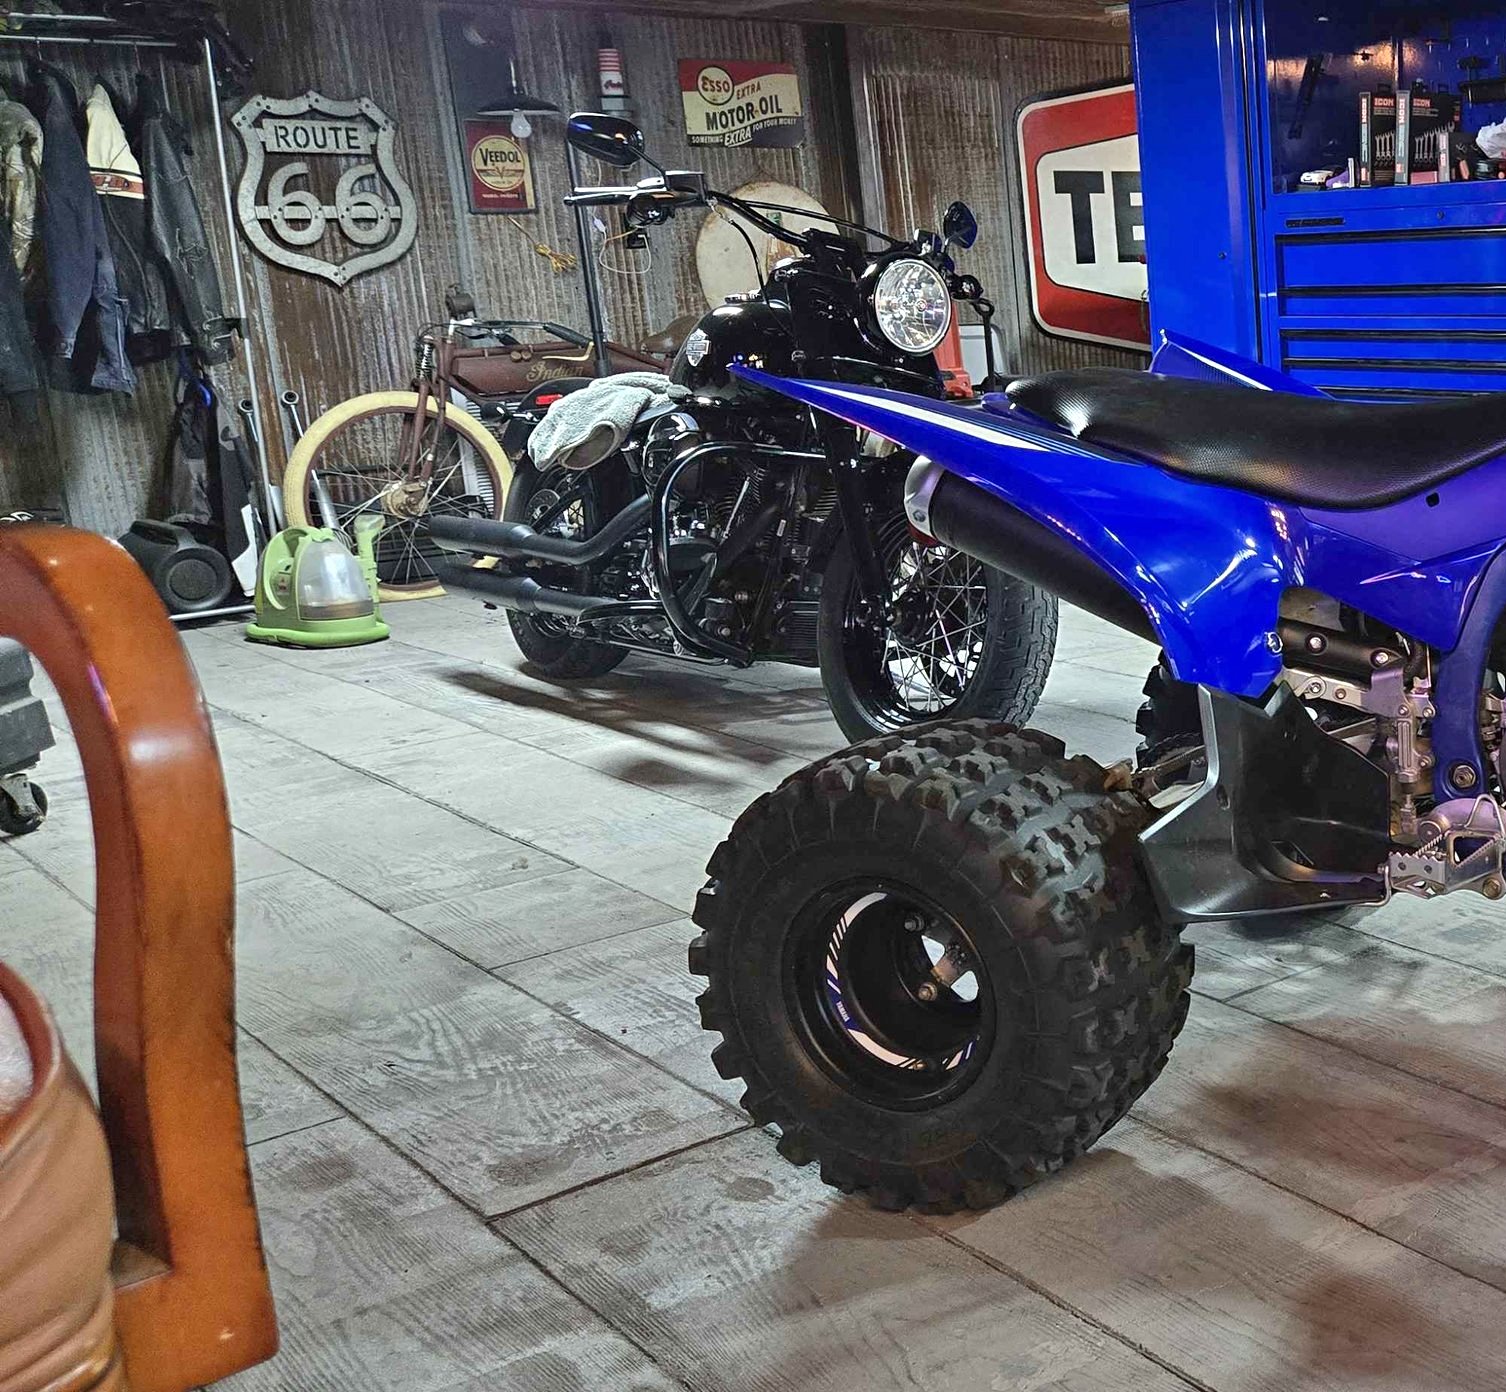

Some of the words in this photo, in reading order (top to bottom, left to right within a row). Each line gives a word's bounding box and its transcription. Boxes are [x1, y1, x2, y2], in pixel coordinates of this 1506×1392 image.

[736, 81, 762, 100] EXTRA
[1374, 97, 1395, 107] ICON
[274, 125, 361, 150] ROUTE
[724, 126, 753, 148] EXTRA
[479, 147, 522, 167] VEEDOL
[267, 161, 391, 246] 66
[526, 361, 584, 382] Indian
